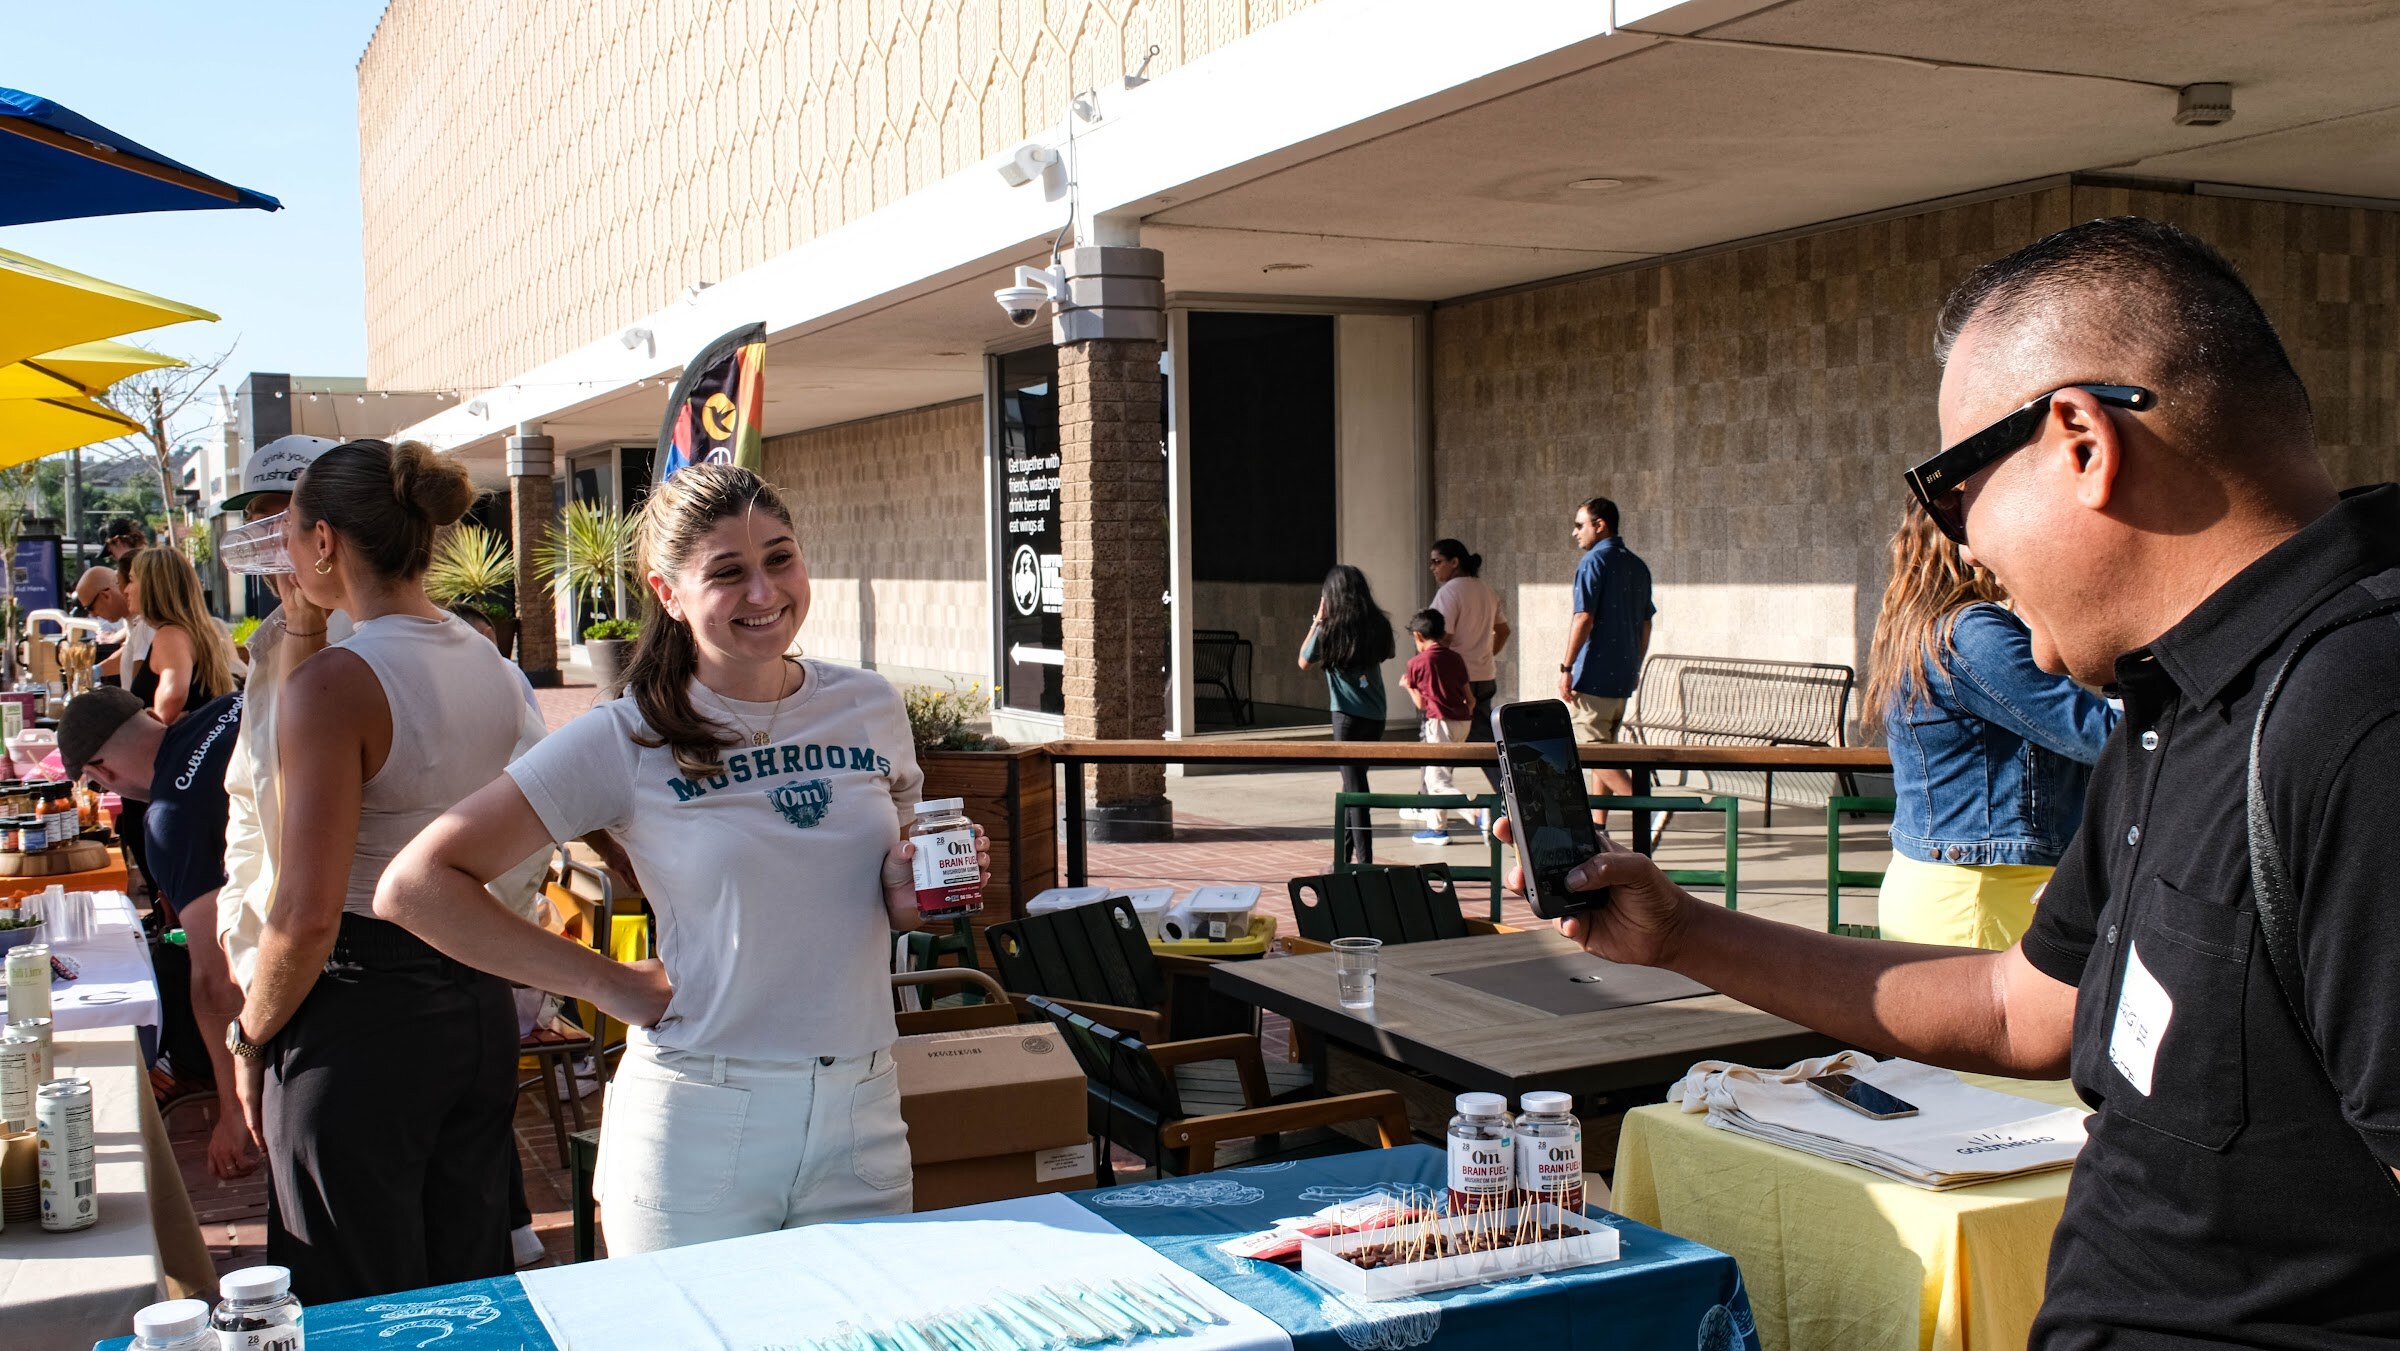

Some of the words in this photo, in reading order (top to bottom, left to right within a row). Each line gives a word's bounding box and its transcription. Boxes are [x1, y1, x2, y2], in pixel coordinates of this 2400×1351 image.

[1008, 458, 1019, 473] Get
[1020, 455, 1044, 475] together
[1045, 453, 1060, 469] with
[1029, 475, 1048, 491] watch
[1008, 497, 1024, 513] drink
[1024, 497, 1038, 512] beer
[1038, 495, 1051, 511] and
[1009, 518, 1020, 533] eat
[1020, 517, 1037, 536] wings
[1038, 517, 1045, 532] at
[174, 723, 226, 790] Cultivate
[667, 744, 892, 802] MUSHROOMS
[948, 842, 972, 856] Om
[939, 858, 964, 869] BRAIN
[1472, 1150, 1501, 1165] Om
[1549, 1147, 1575, 1162] Om
[1462, 1165, 1487, 1176] BRAIN
[1538, 1164, 1564, 1174] BRAIN
[248, 1335, 259, 1345] 28
